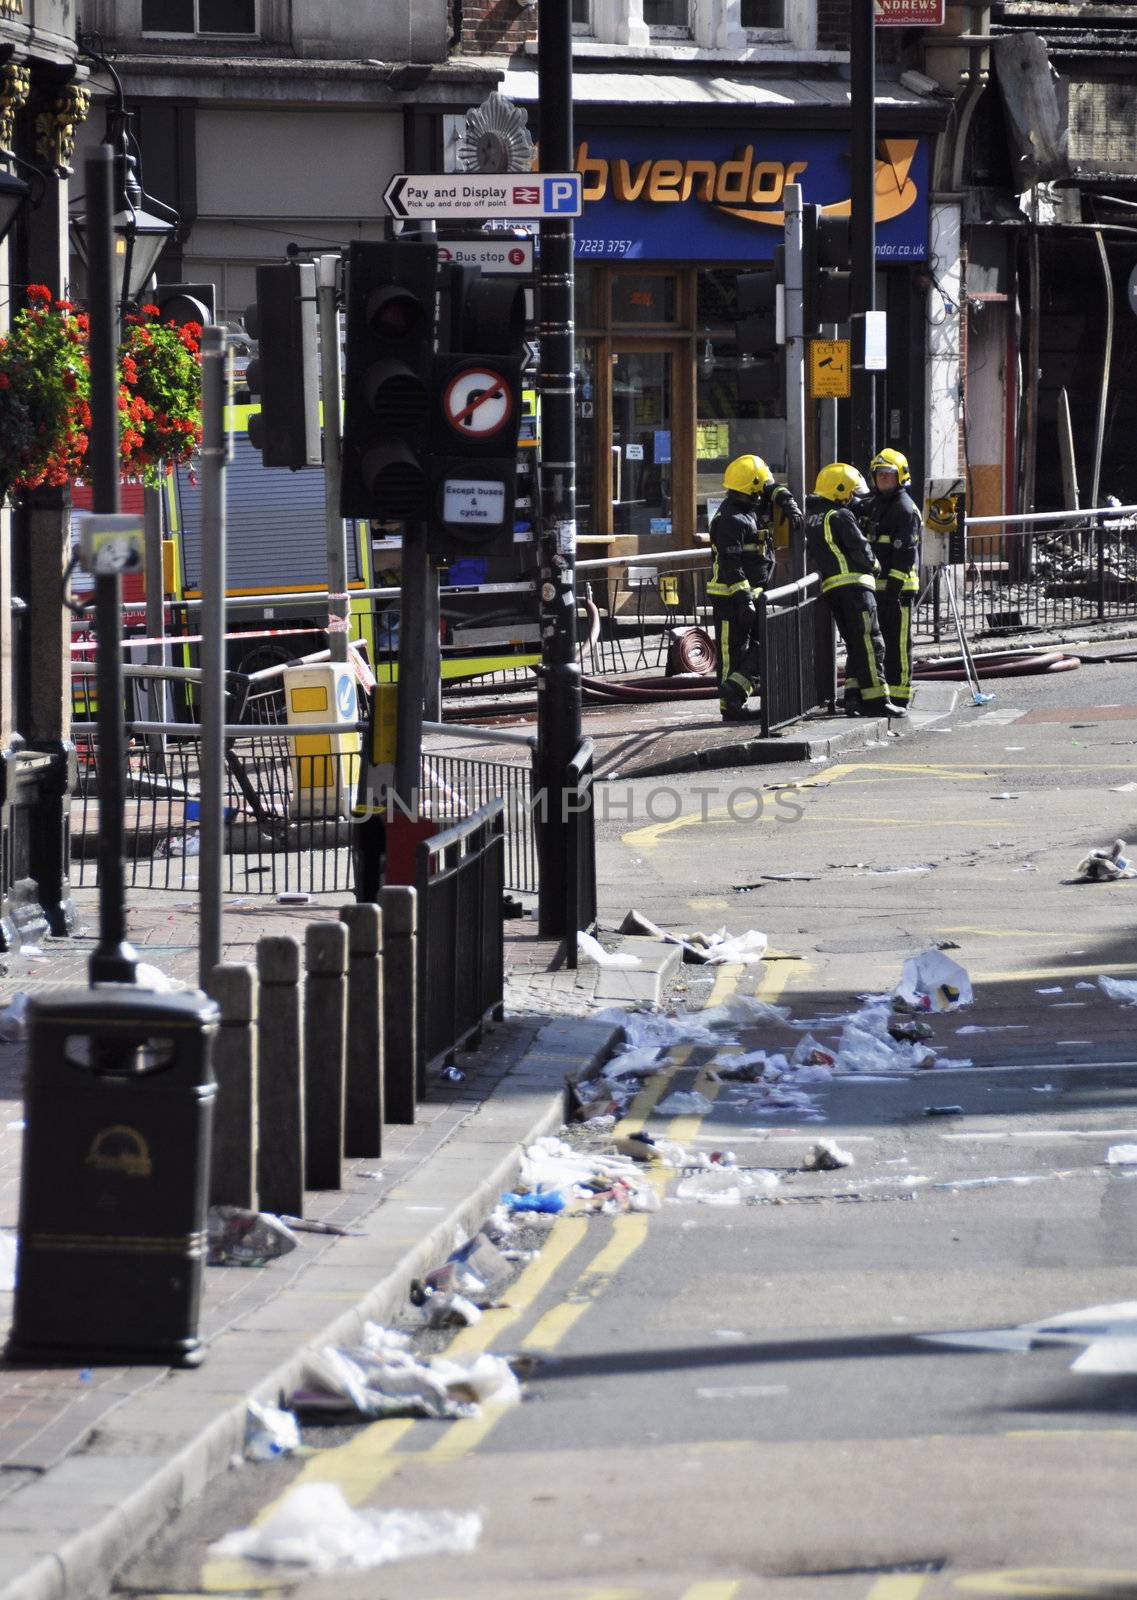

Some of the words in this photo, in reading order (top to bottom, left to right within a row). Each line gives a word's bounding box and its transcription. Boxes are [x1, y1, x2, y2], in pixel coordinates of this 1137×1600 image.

[613, 144, 808, 203] vendor
[407, 187, 429, 199] Pay
[434, 187, 457, 198] and
[462, 187, 507, 199] Display
[551, 182, 574, 210] P
[454, 200, 472, 208] drop
[487, 200, 507, 208] point
[579, 240, 605, 252] 7223
[607, 240, 632, 252] 3757
[875, 244, 925, 256] ndor.co.uk
[455, 251, 477, 262] Bus
[480, 252, 505, 263] stop
[512, 252, 521, 261] E
[817, 346, 844, 354] CCTV
[446, 486, 475, 495] Except
[477, 487, 504, 496] buses
[459, 509, 488, 517] cycles
